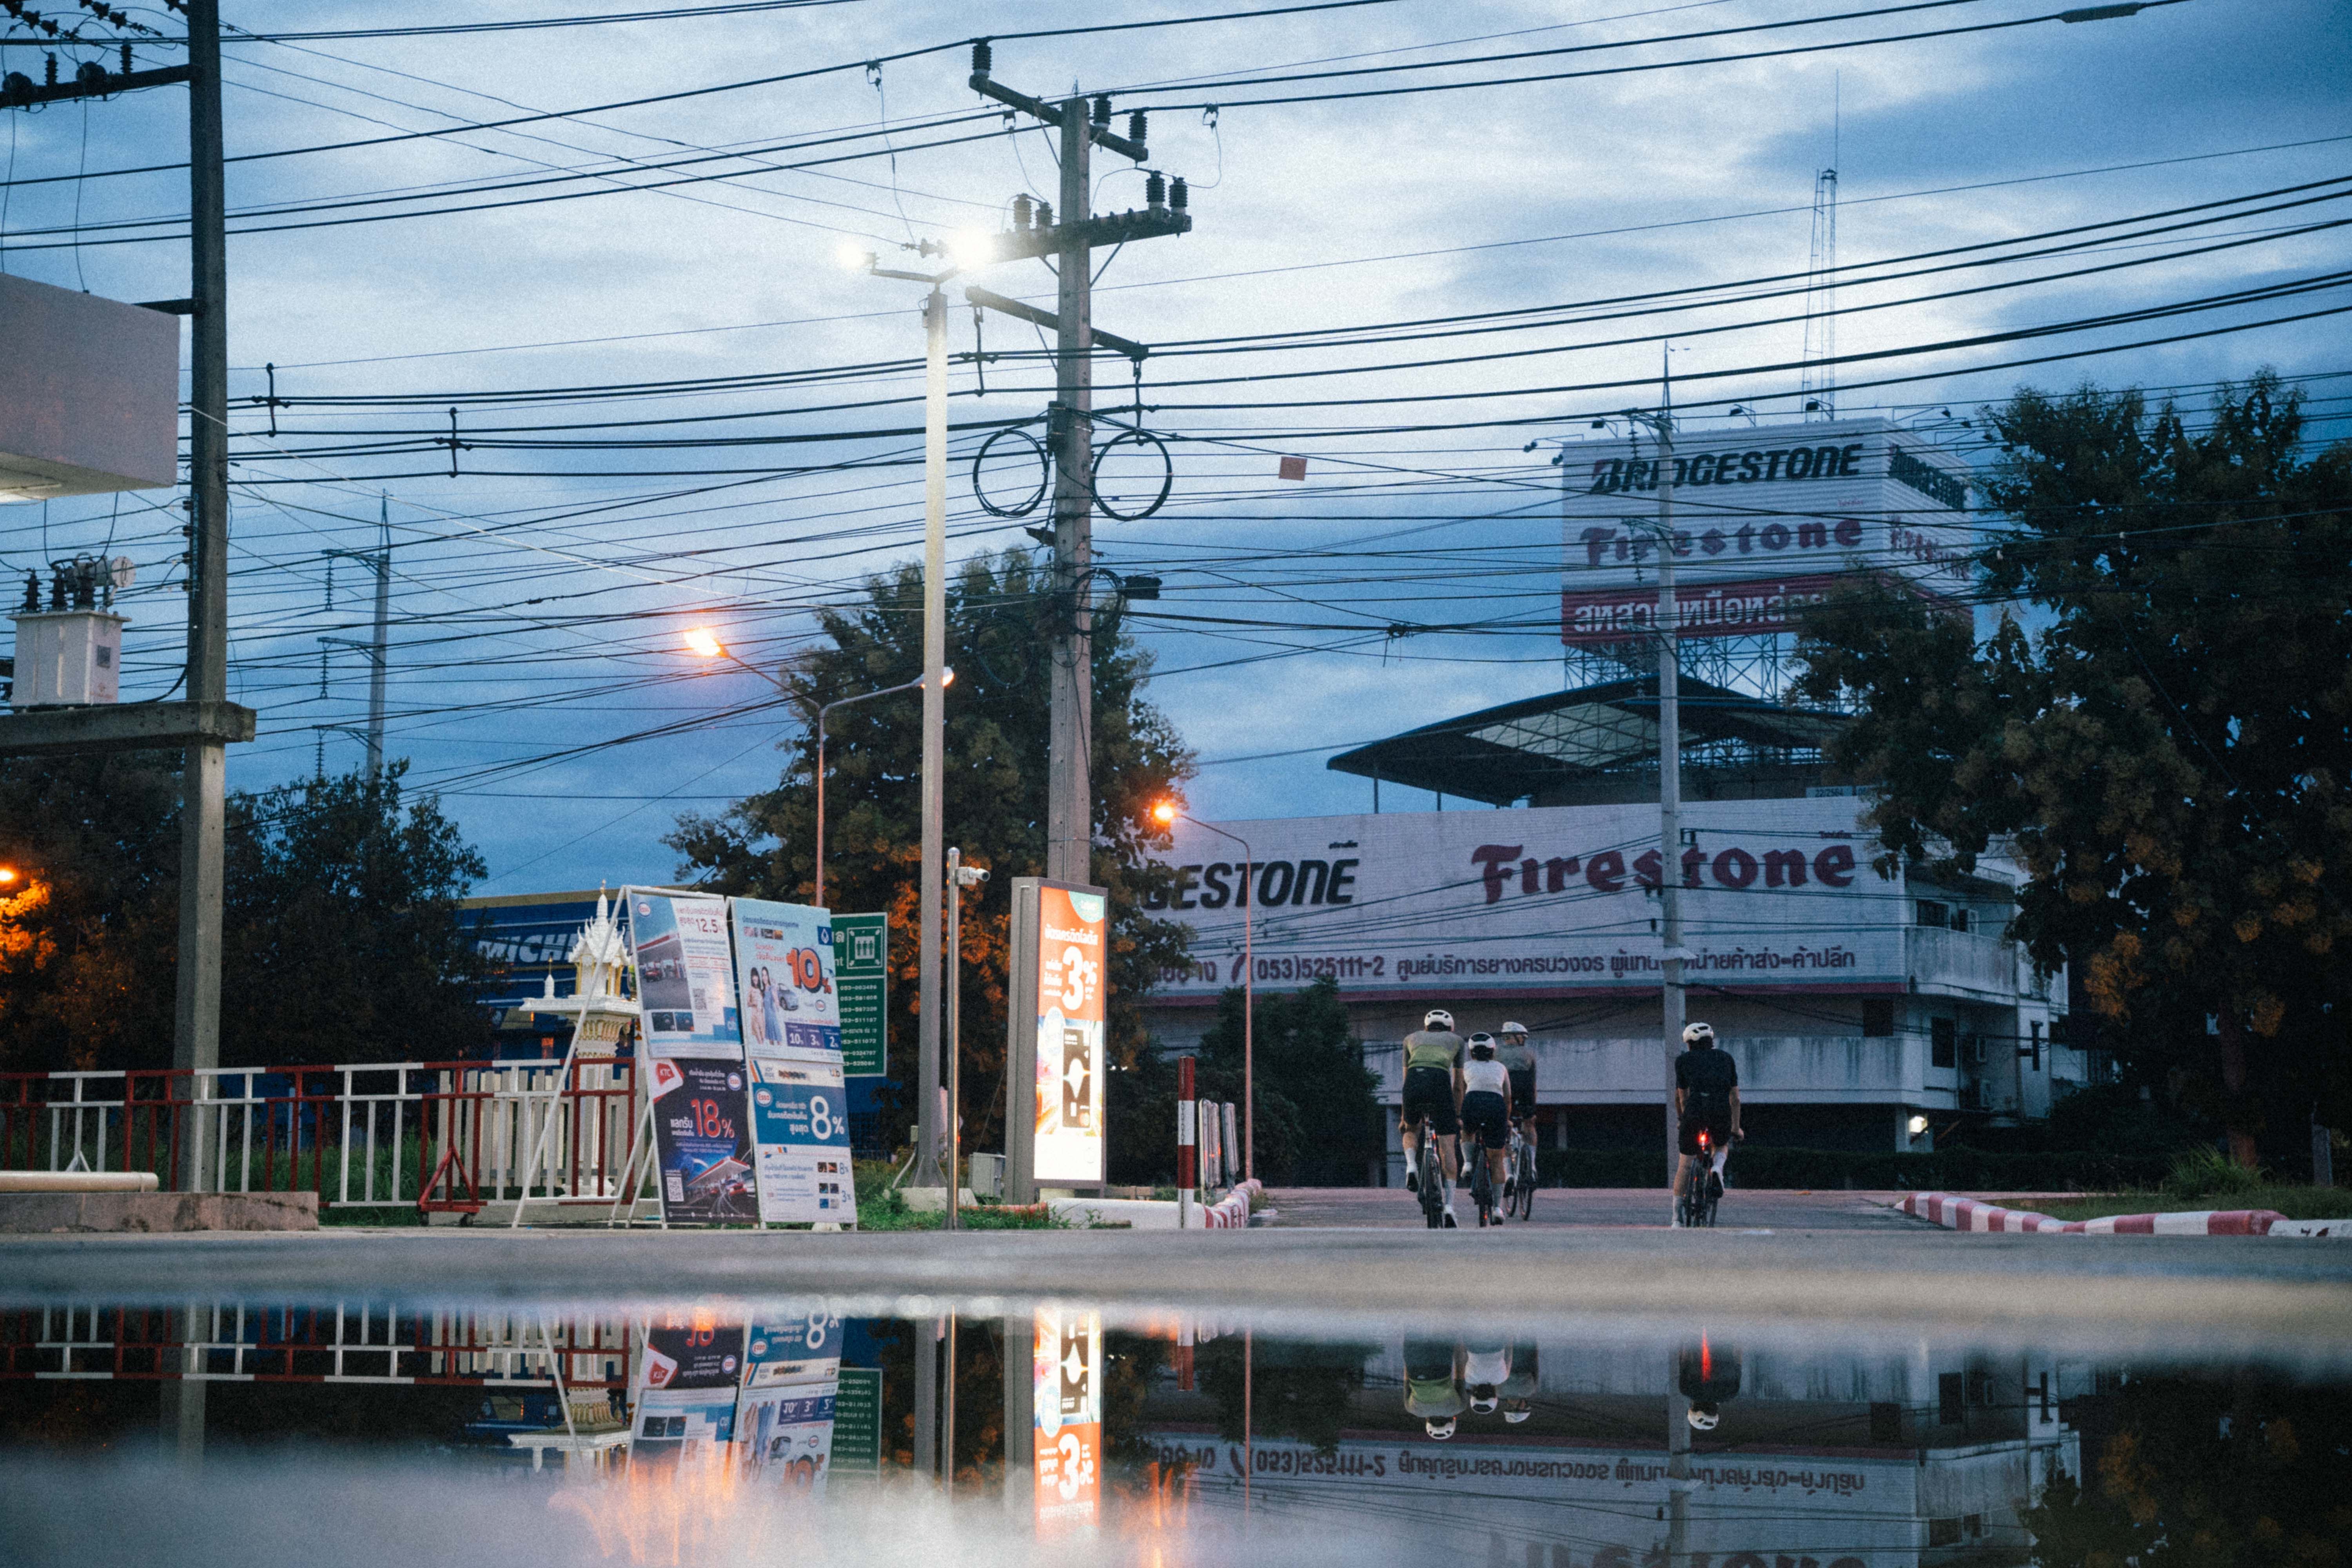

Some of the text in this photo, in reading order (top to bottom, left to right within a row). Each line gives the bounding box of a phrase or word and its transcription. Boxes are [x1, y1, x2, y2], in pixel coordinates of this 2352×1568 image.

[1590, 443, 1863, 494] BRIDGESTONE
[1580, 518, 1863, 566] Firestone
[1472, 844, 1855, 904] Firestone
[1610, 945, 1855, 978] ผู้แทนหน่ายค้าส่ง-ค้าปลีก
[659, 1068, 671, 1077] KTC
[670, 1098, 735, 1138] แลกรับ 18%
[789, 1096, 845, 1140] สูงสุด 8%
